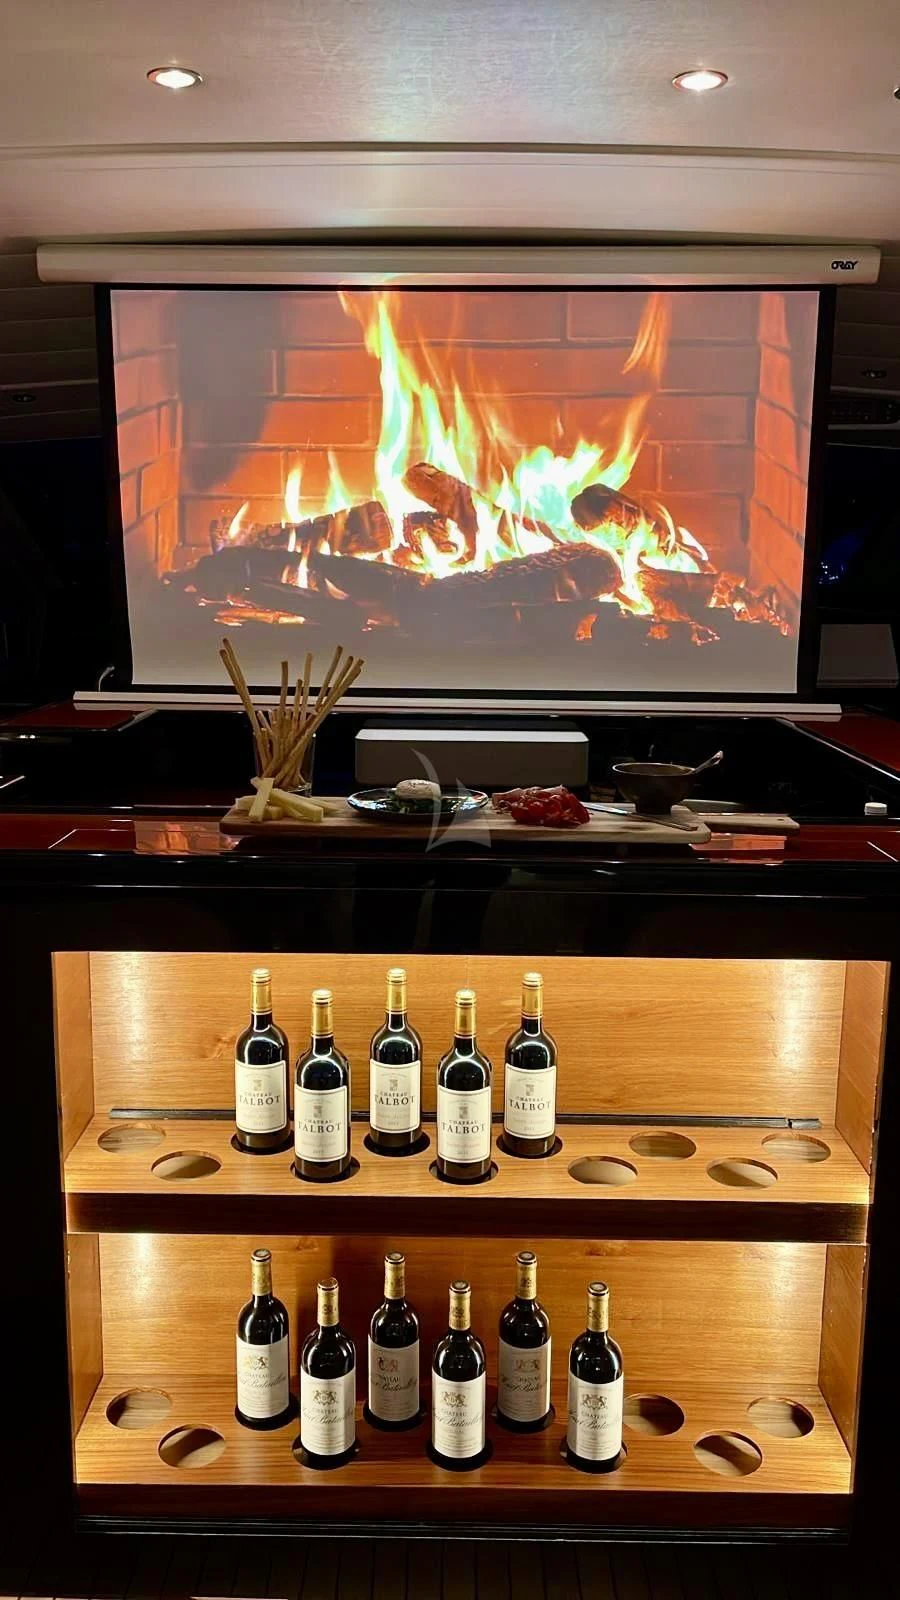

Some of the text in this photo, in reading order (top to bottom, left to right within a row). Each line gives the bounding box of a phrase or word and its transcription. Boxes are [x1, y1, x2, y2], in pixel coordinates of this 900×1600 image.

[831, 260, 859, 270] ORAY
[239, 1094, 281, 1106] TALBOT
[374, 1094, 416, 1106] TALBOT
[508, 1098, 551, 1111] TALBOT
[298, 1120, 342, 1134] TALBOT
[441, 1121, 487, 1134] TALBOT
